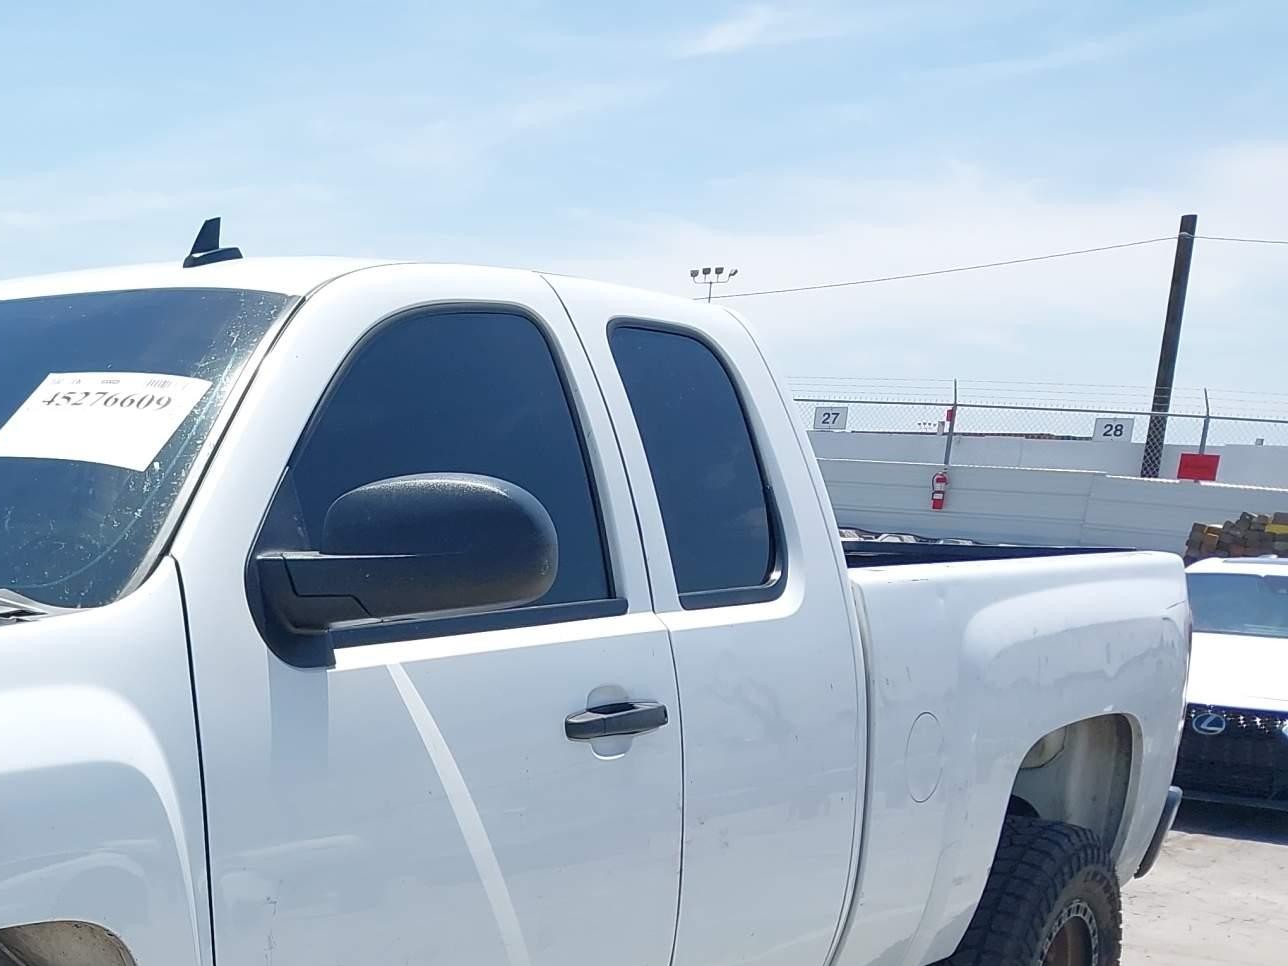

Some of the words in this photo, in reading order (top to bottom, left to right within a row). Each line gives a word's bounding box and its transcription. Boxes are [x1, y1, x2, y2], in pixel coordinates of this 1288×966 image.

[41, 390, 173, 411] 45276609
[821, 412, 841, 424] 27
[1102, 423, 1124, 437] 28
